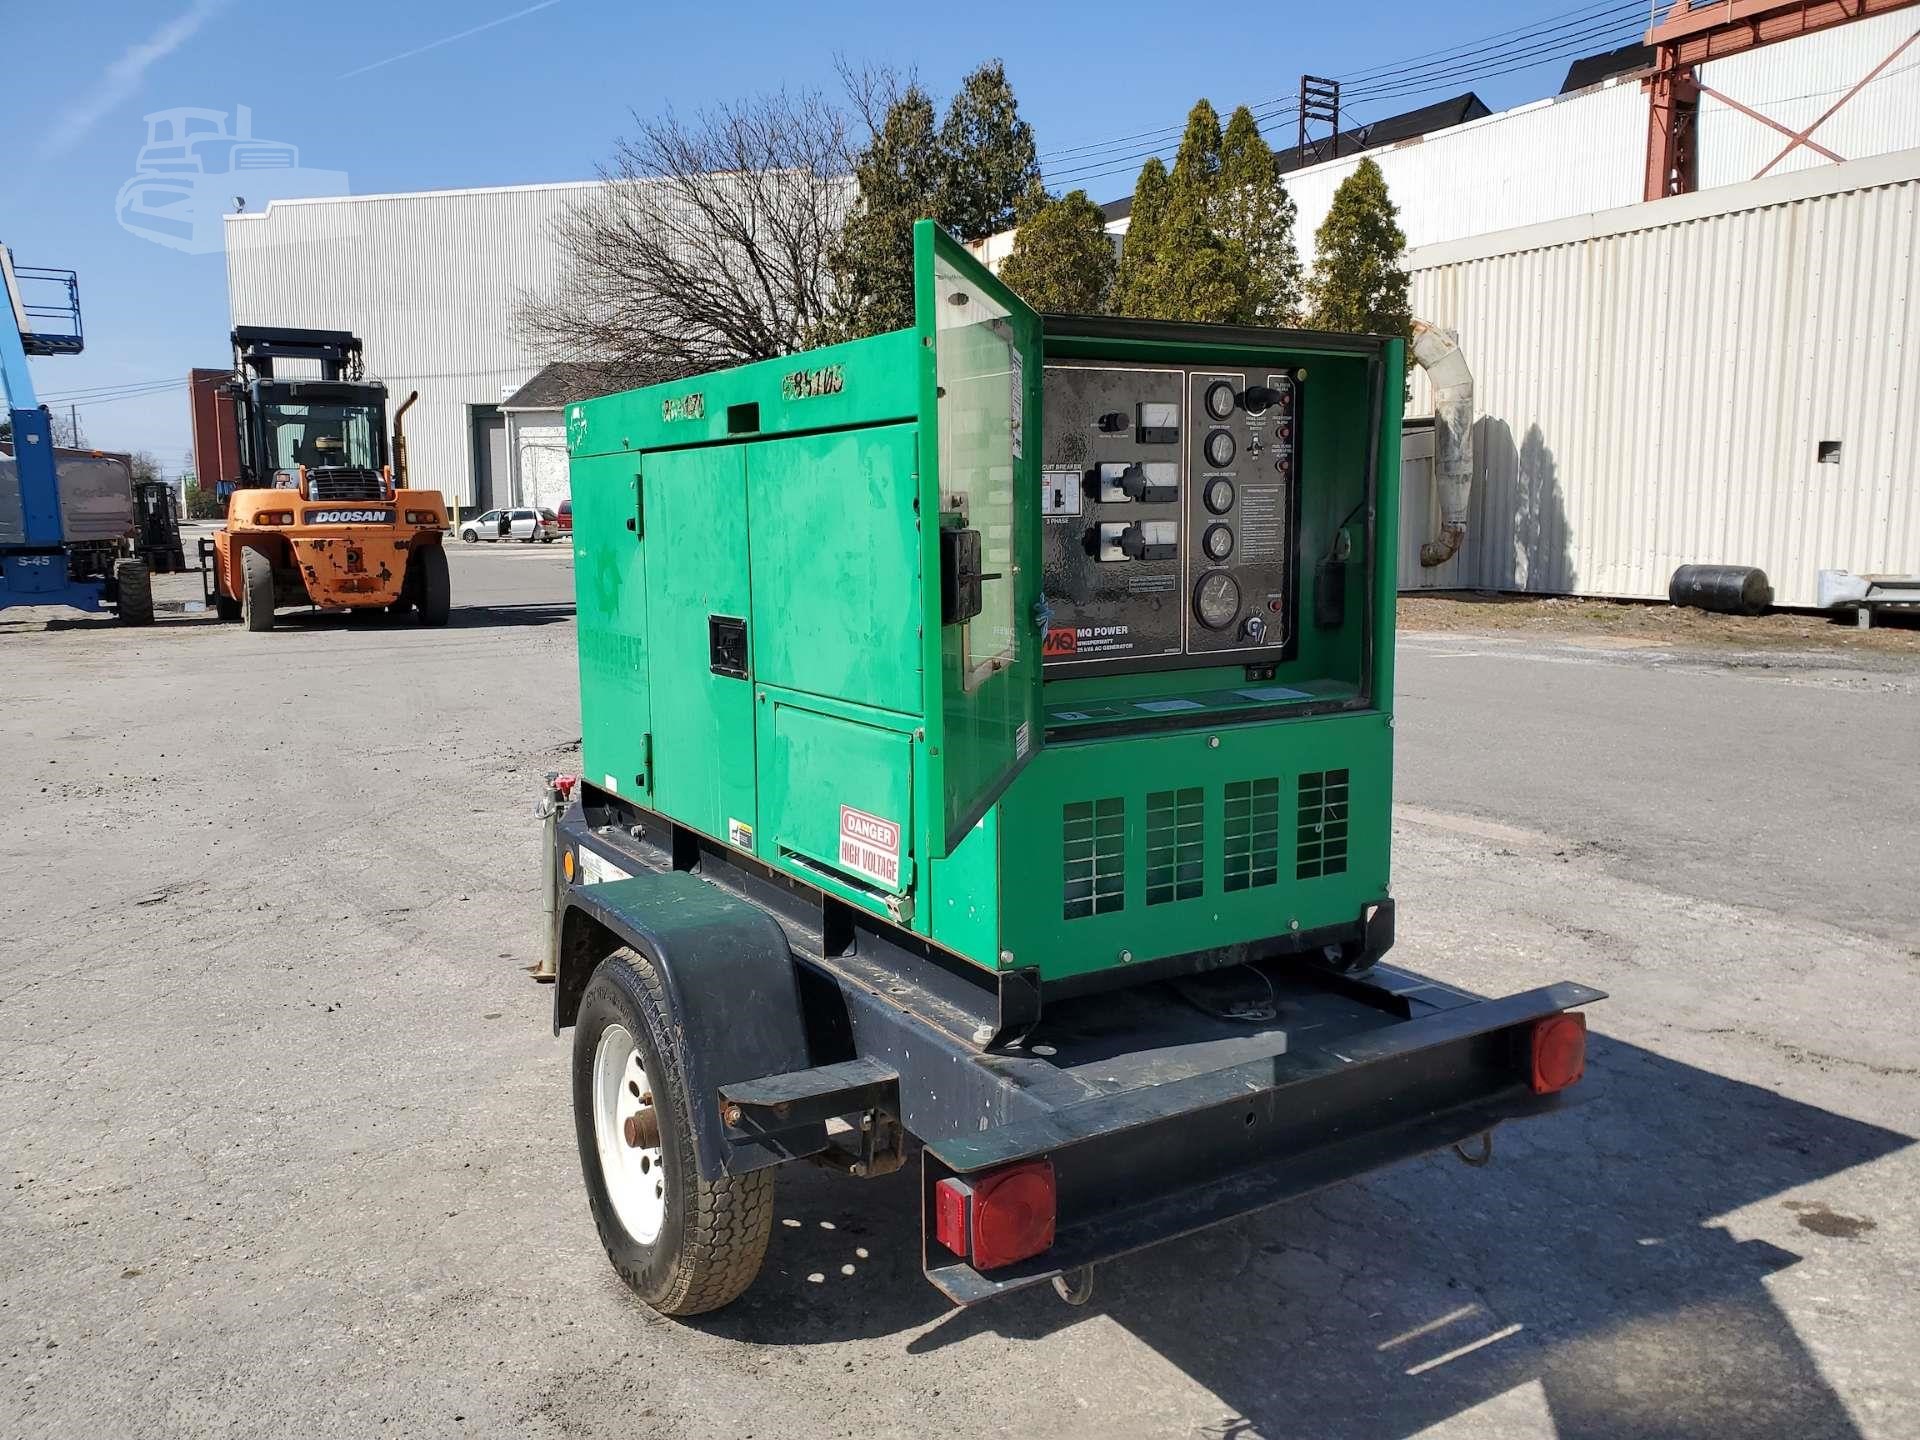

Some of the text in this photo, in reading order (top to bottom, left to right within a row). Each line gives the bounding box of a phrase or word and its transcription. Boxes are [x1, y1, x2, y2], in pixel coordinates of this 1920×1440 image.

[316, 511, 386, 522] DOOSAN
[19, 556, 50, 567] S-45
[1077, 626, 1128, 637] MQ POWER
[847, 815, 891, 846] DANGER
[842, 840, 897, 882] HIGH VOLTAGE
